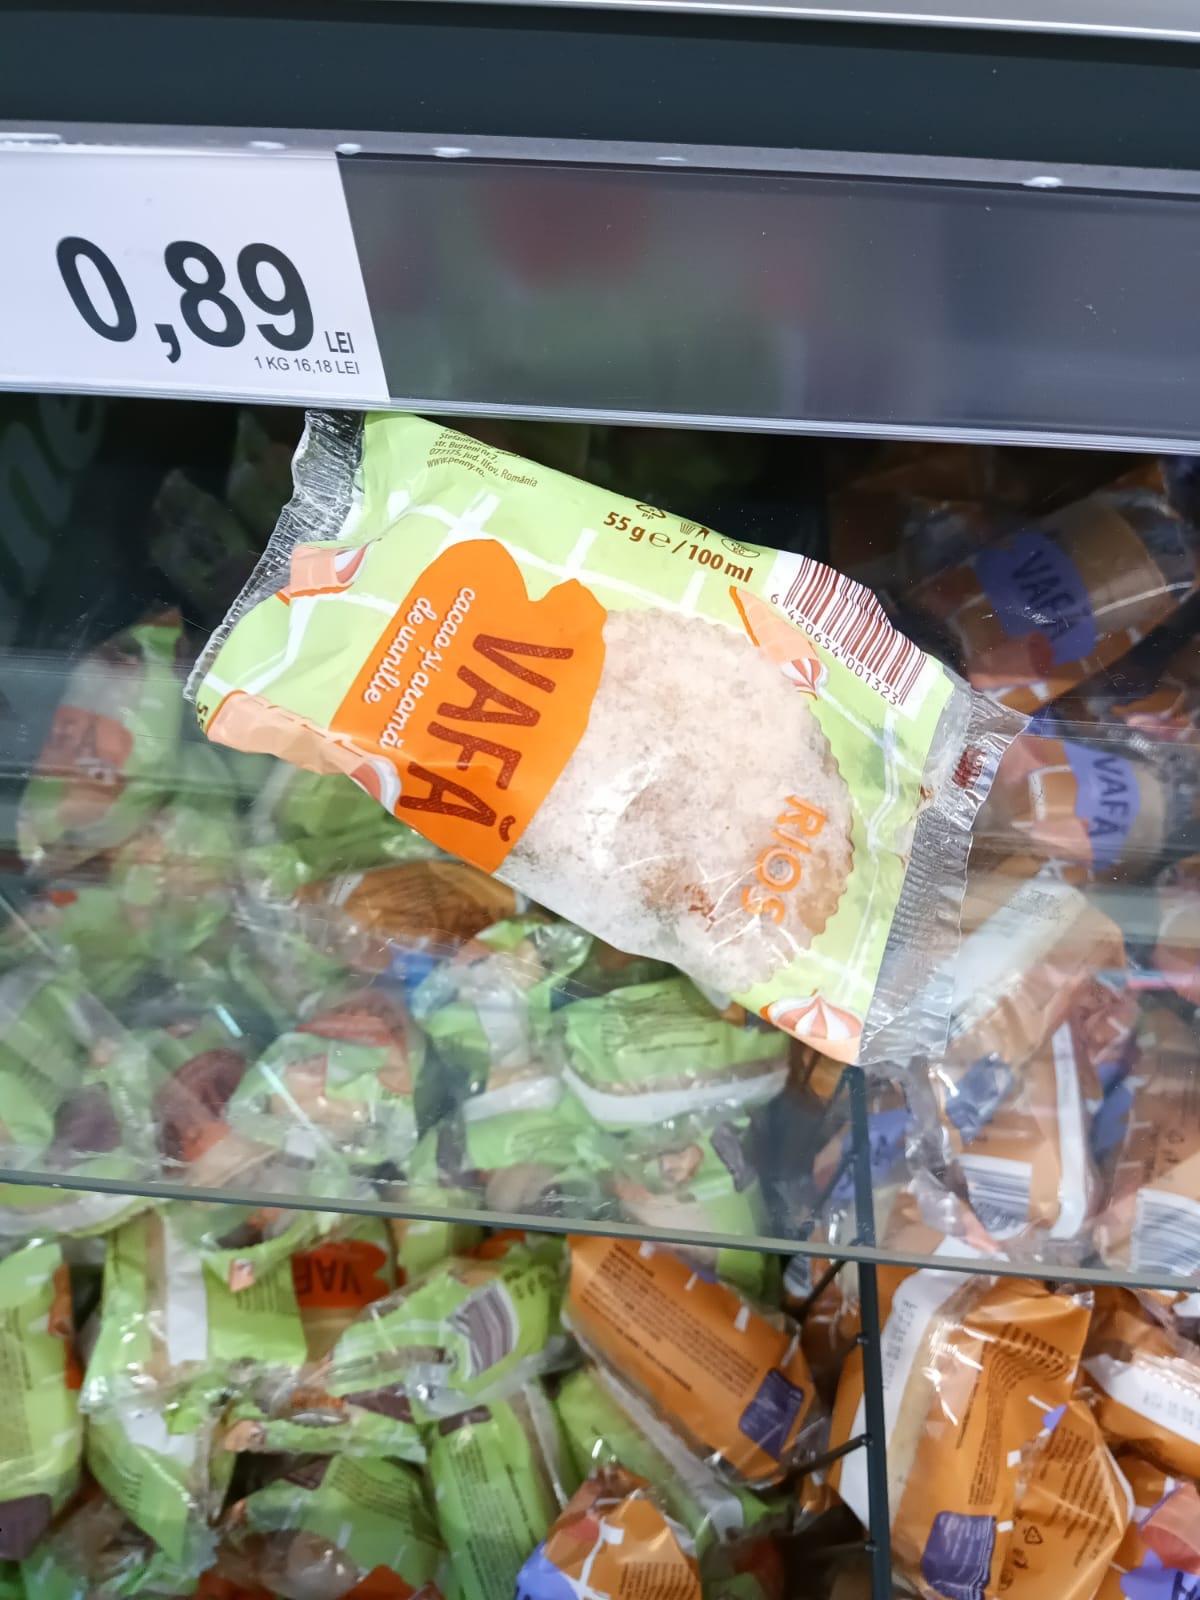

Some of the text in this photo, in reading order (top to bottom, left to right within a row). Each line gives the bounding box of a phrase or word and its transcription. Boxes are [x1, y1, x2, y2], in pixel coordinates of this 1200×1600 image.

[56, 236, 355, 364] 0,89 LEI
[254, 356, 360, 375] 1 KG 16,18 LEI
[462, 451, 479, 462] jud.
[480, 459, 499, 477] Ilfov,
[500, 469, 539, 488] România
[363, 596, 438, 704] de vanilie
[379, 587, 476, 750] cacao și aromă
[399, 633, 575, 842] VAFĂ
[741, 794, 830, 927] RIOS
